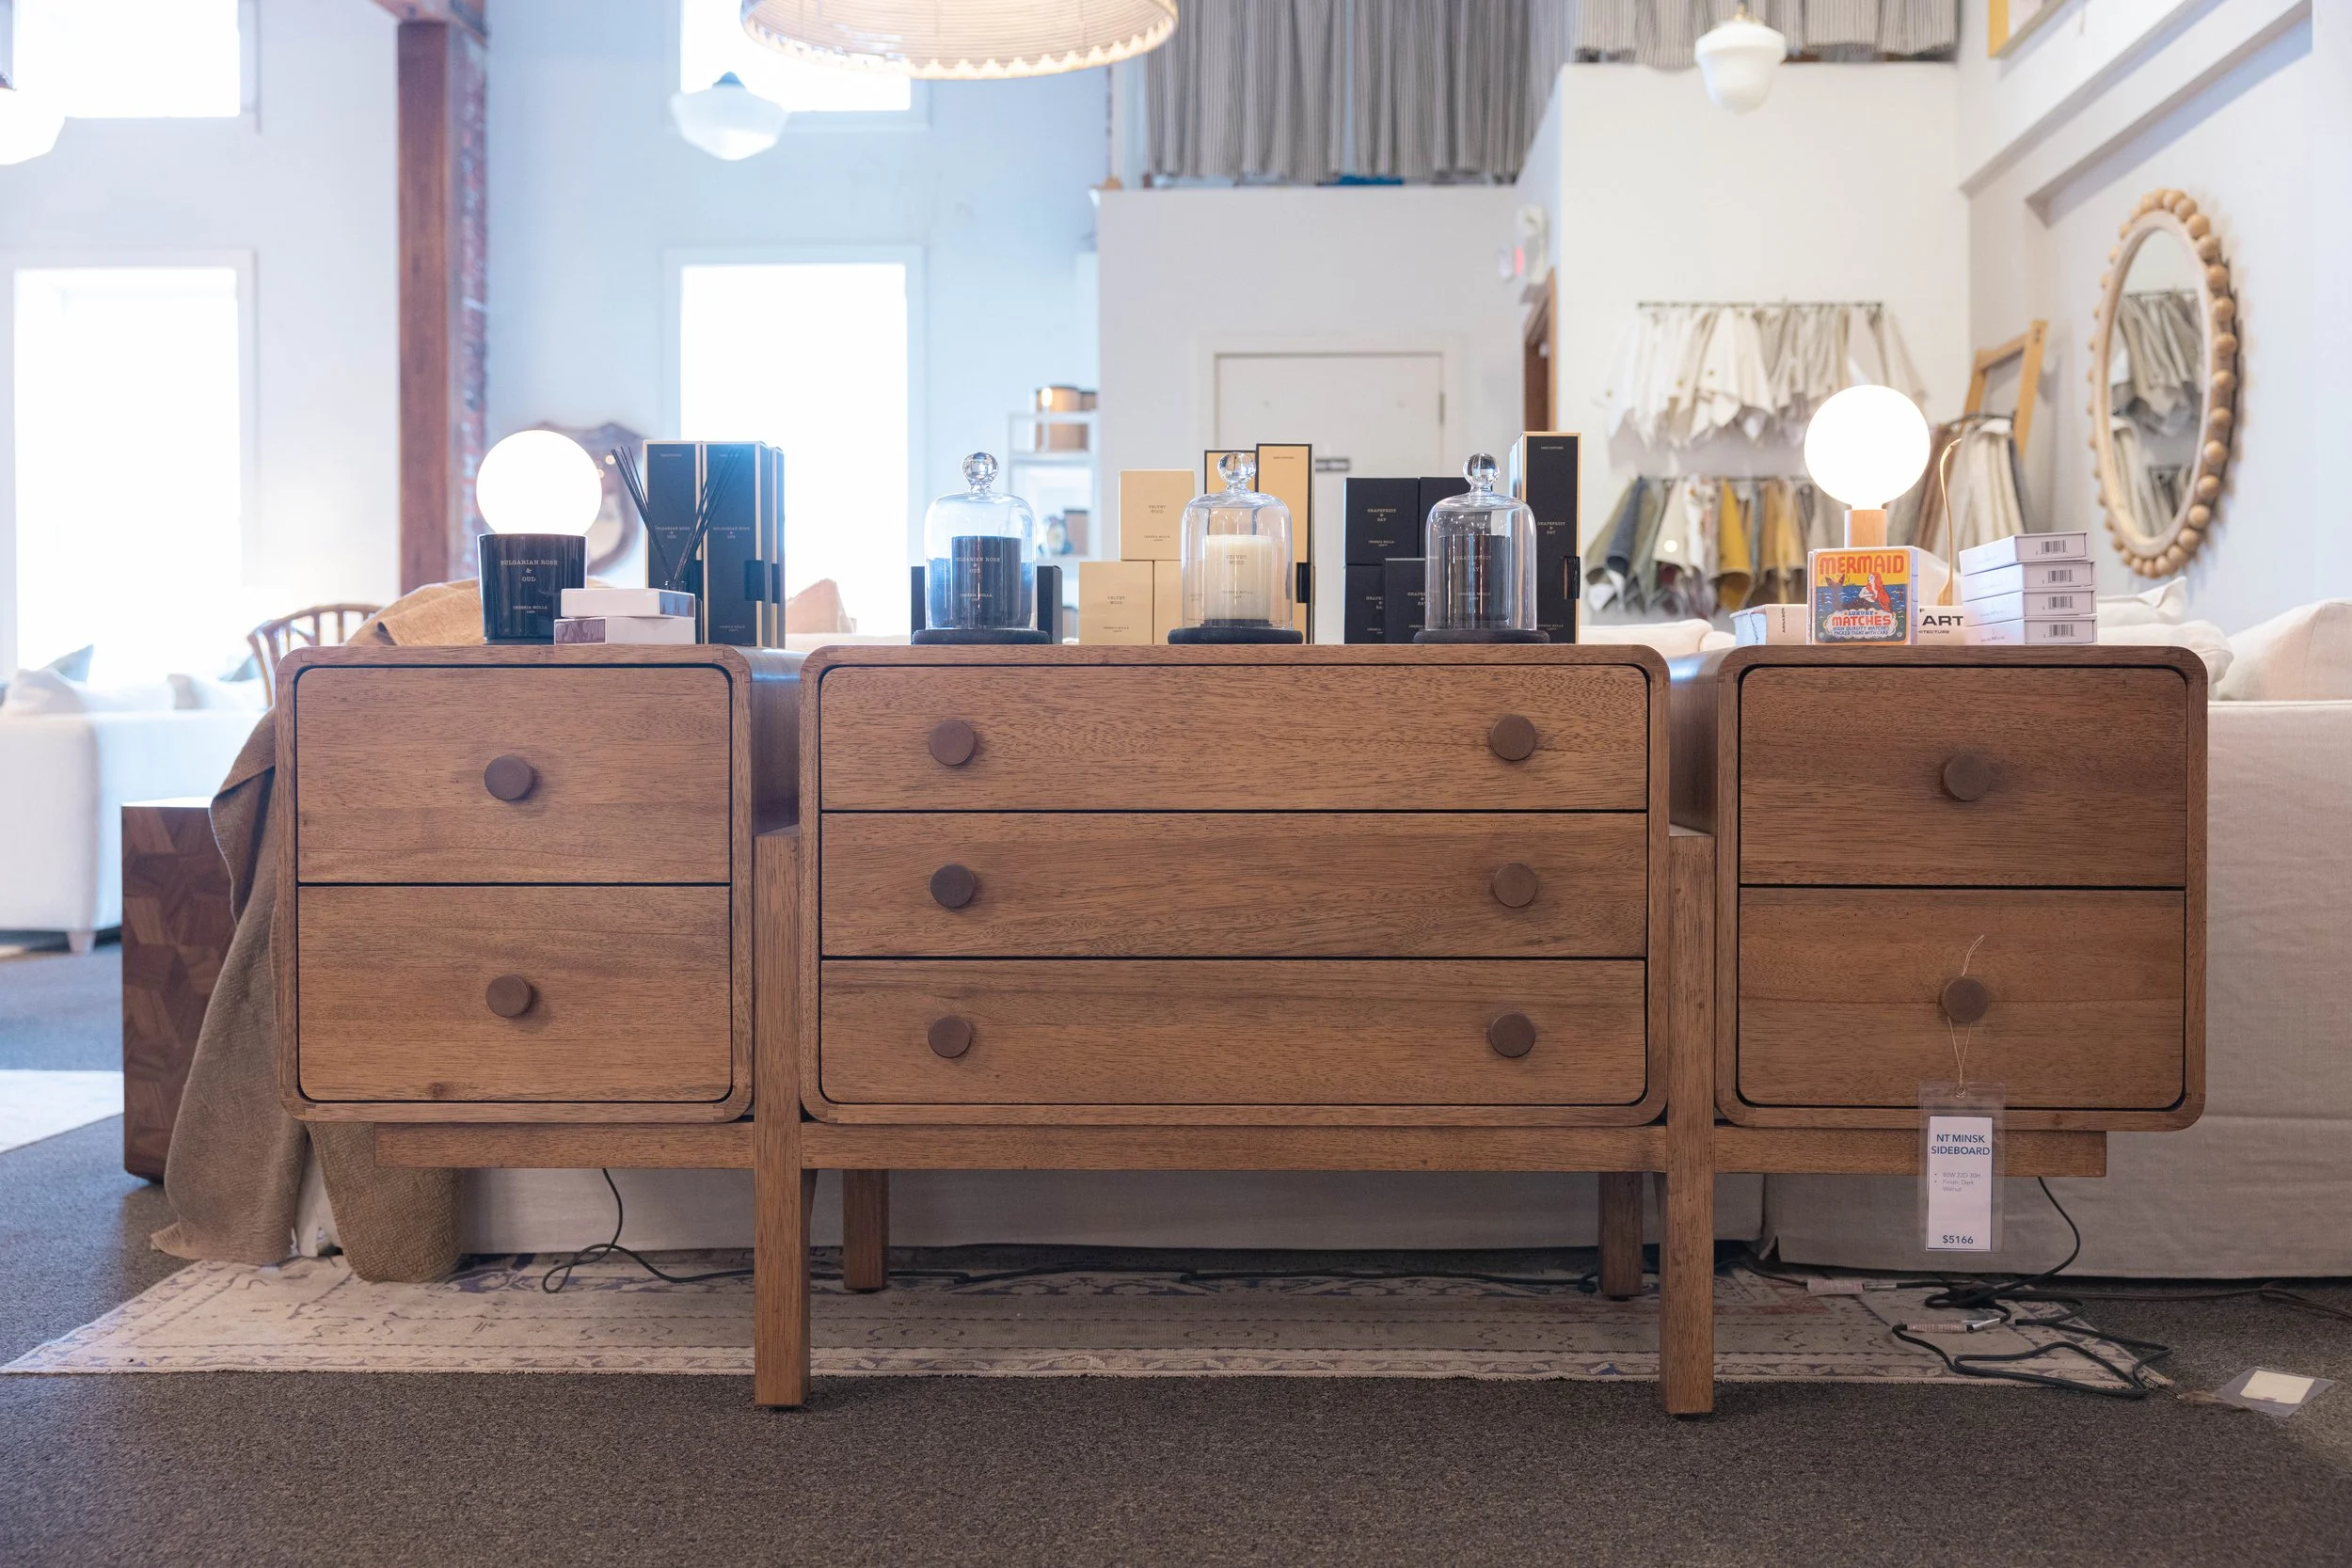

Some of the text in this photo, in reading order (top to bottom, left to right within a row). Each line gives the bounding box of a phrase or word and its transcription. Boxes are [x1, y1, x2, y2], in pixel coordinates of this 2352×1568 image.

[1820, 555, 1904, 574] MERMAID
[1833, 615, 1891, 626] MATCHES
[1922, 616, 1963, 626] ART
[1953, 1134, 1985, 1143] MINSK
[1931, 1147, 1990, 1155] SIDEBOARD
[1943, 1235, 1974, 1244] $5166
